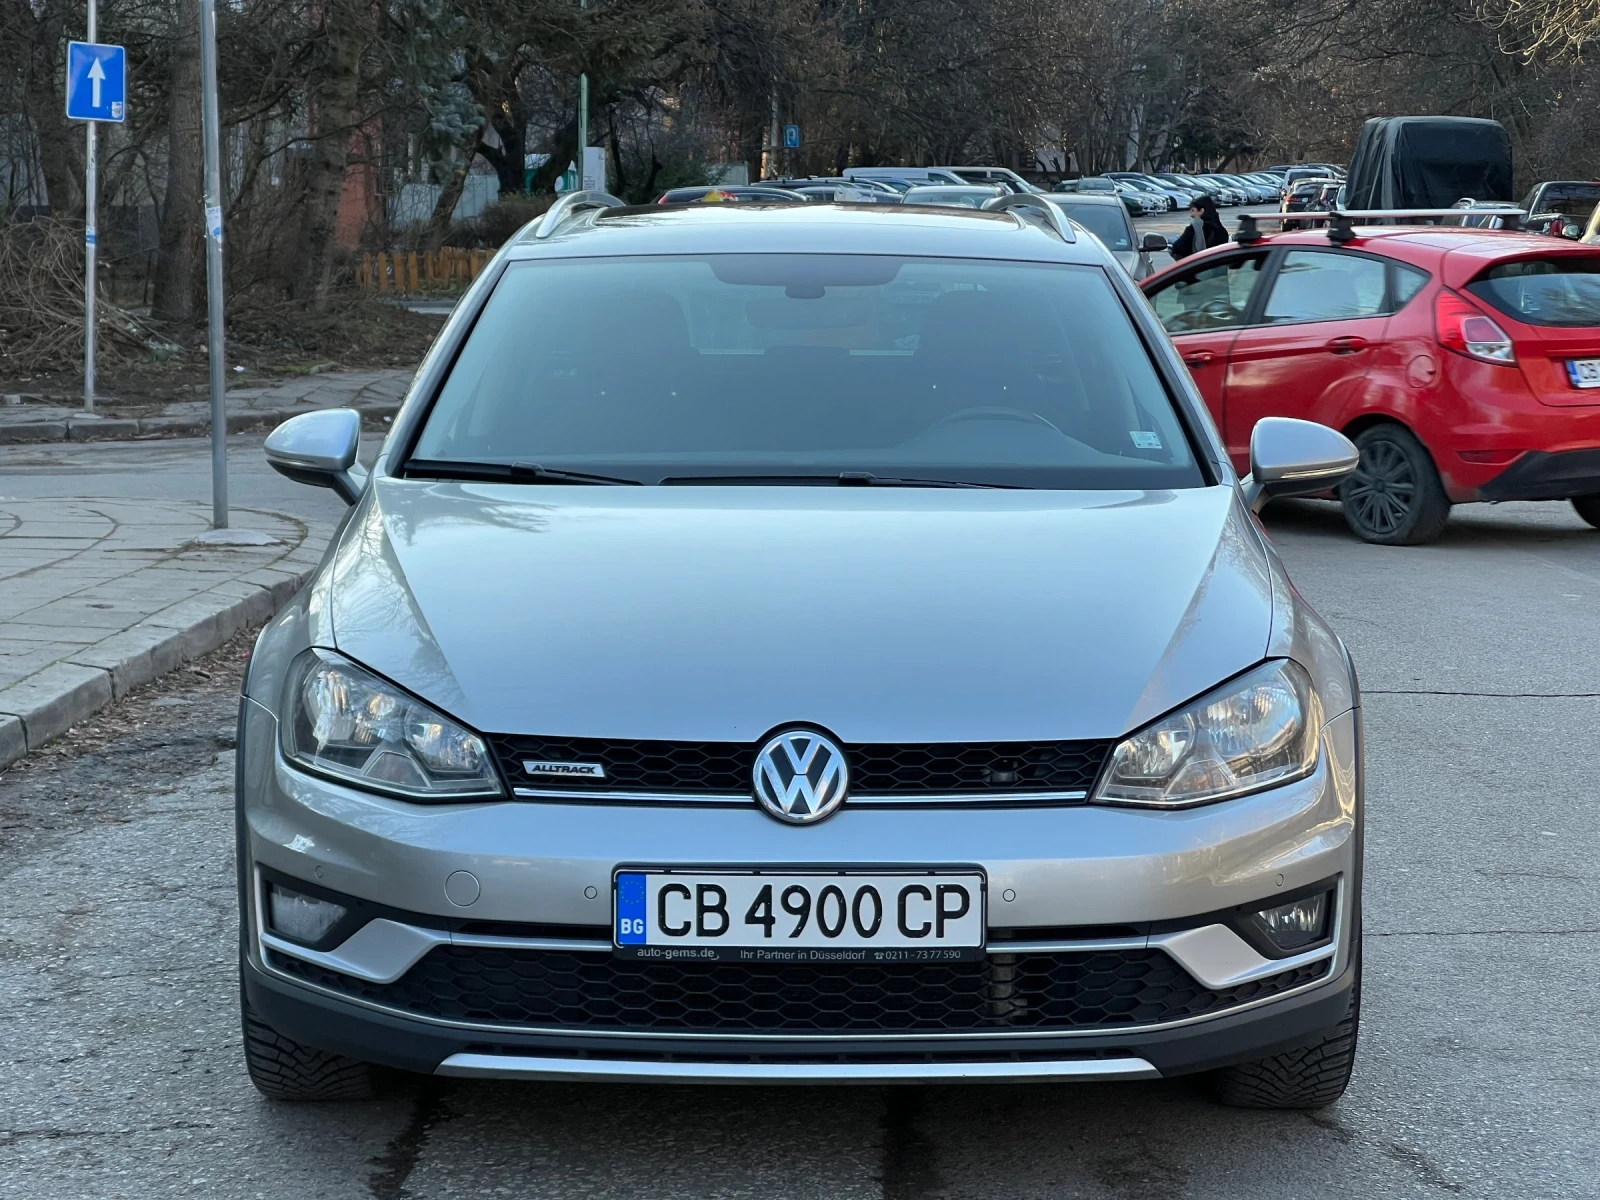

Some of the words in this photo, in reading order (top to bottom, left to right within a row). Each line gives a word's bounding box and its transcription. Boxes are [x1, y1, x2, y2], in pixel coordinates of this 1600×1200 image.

[786, 128, 796, 145] P
[532, 764, 595, 774] ALLTRACK
[656, 883, 730, 937] CB
[744, 883, 883, 939] 4900
[896, 883, 971, 939] CP
[620, 918, 644, 935] BG
[637, 947, 715, 960] auto-gems.de
[740, 949, 754, 959] Ihr
[757, 949, 796, 960] Partner
[798, 950, 807, 960] in
[810, 950, 865, 960] Düsseldorf
